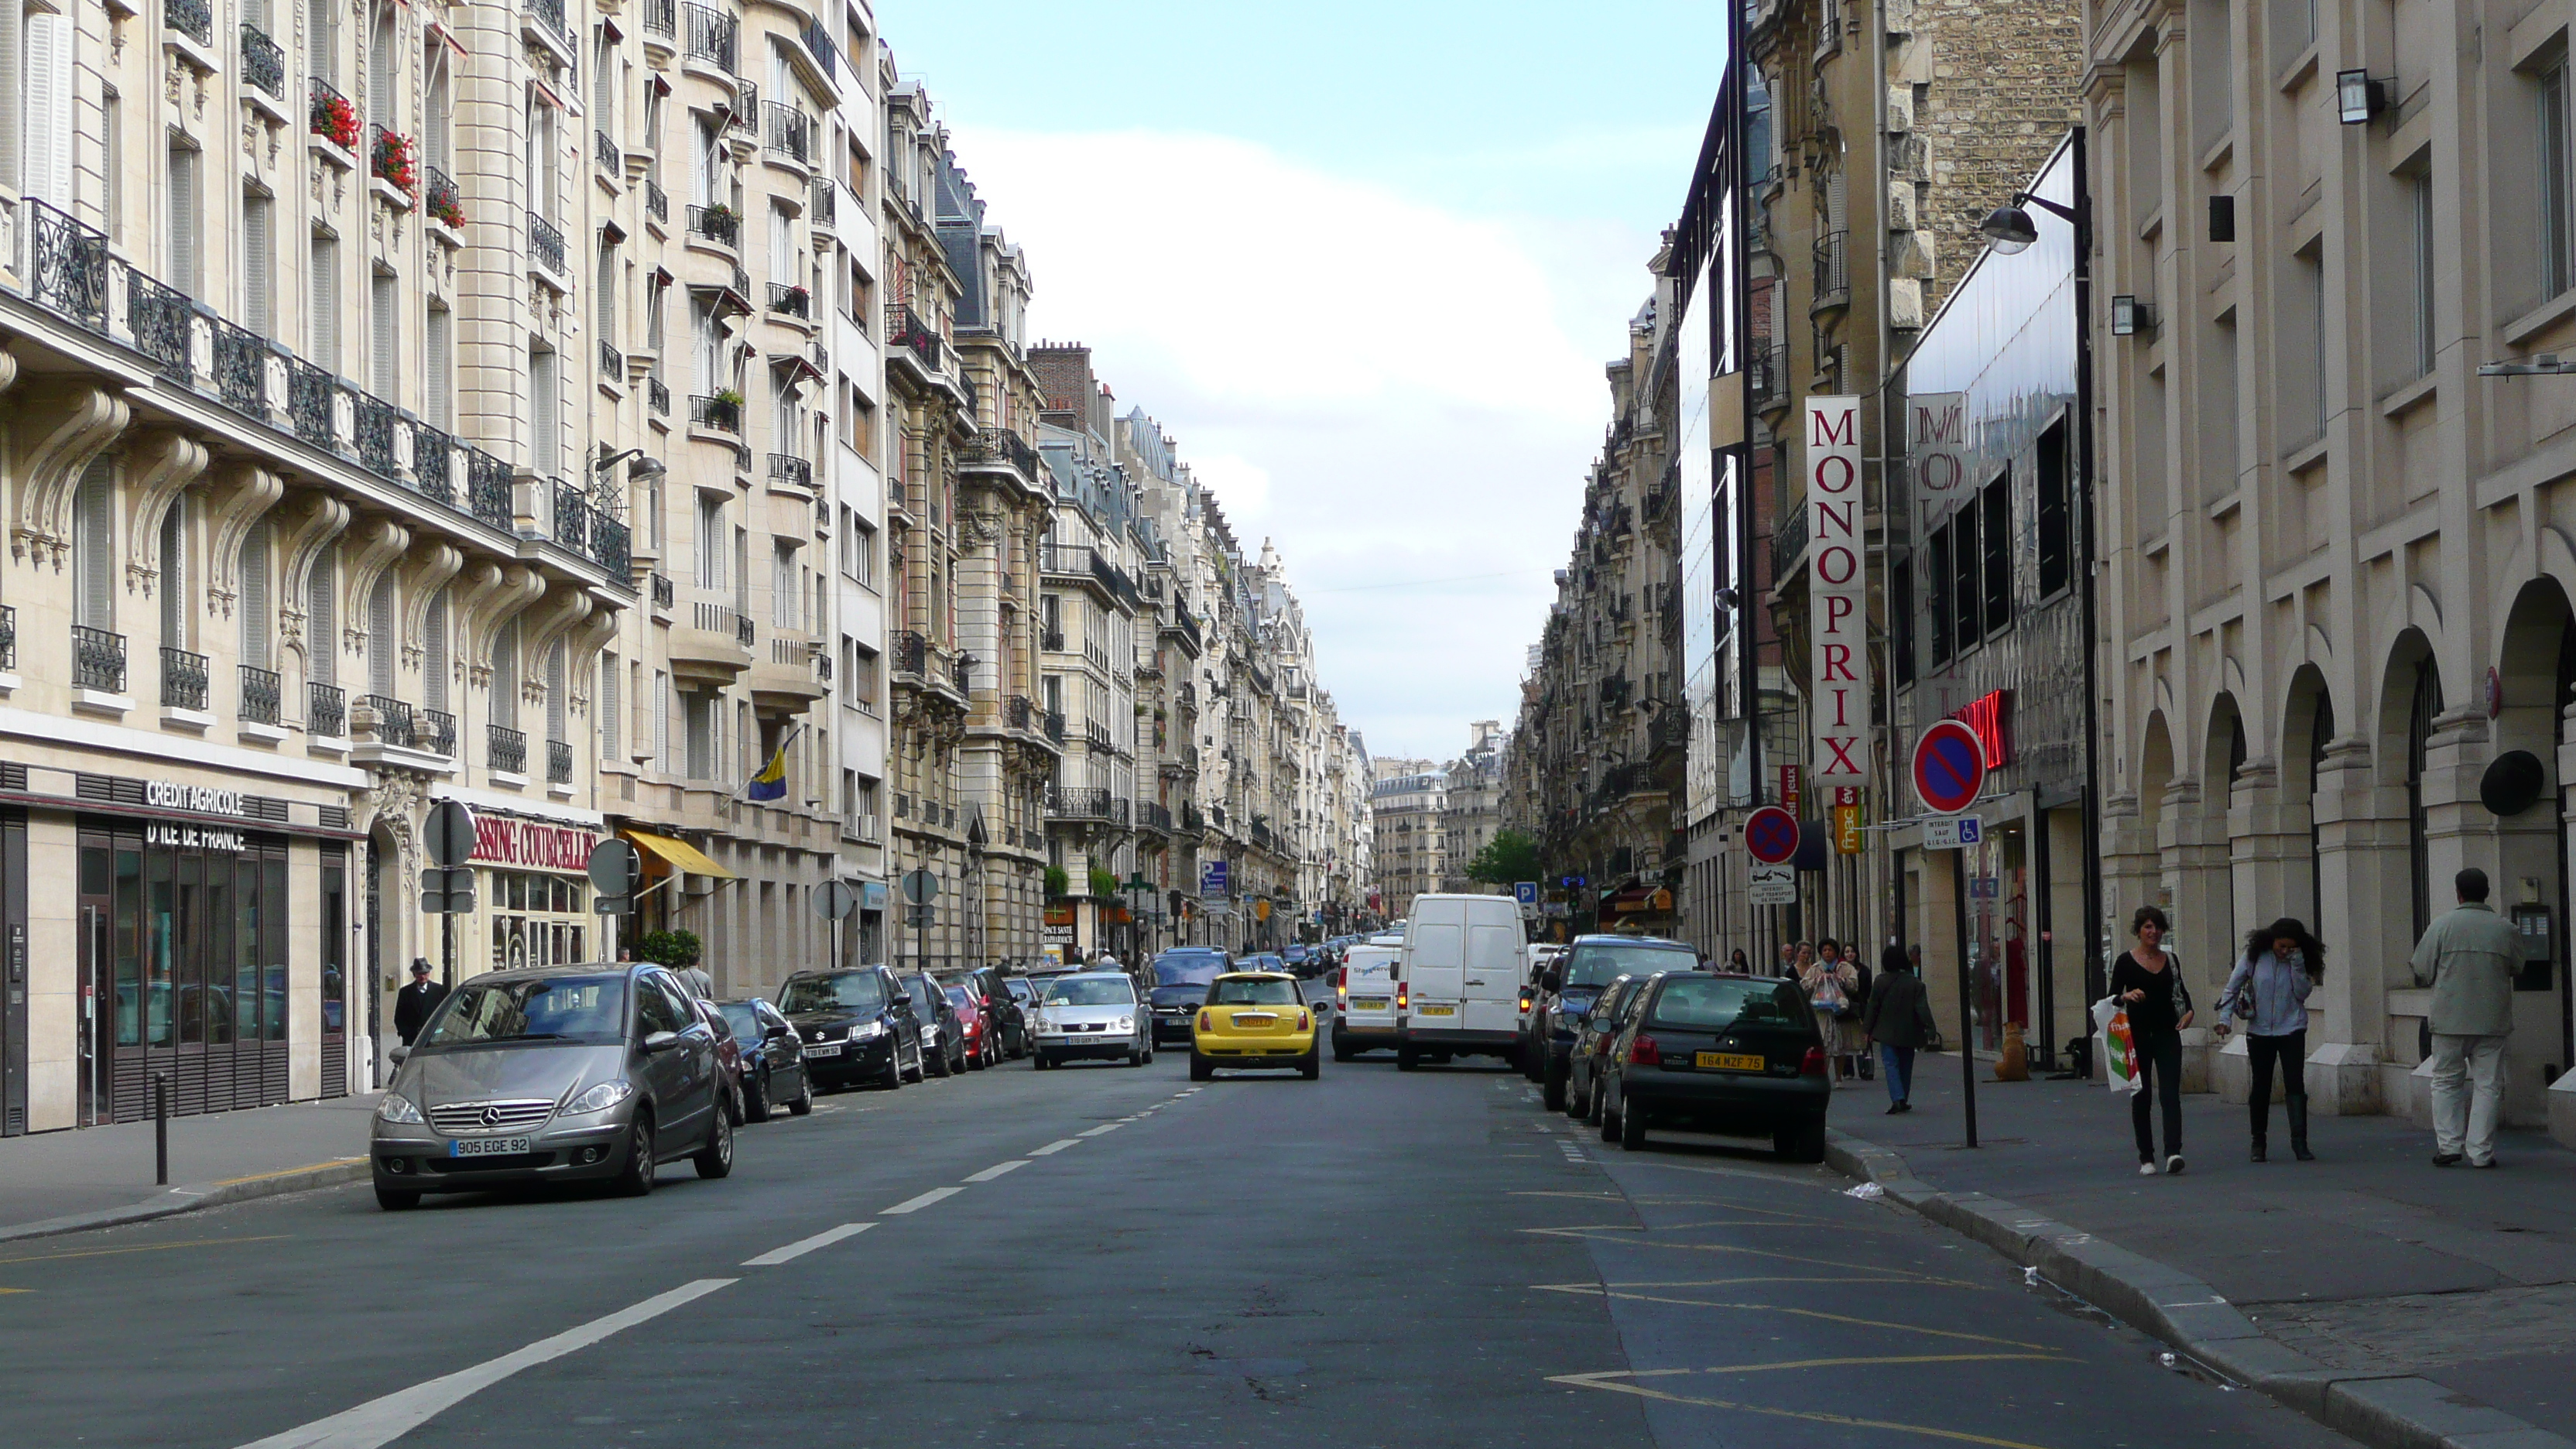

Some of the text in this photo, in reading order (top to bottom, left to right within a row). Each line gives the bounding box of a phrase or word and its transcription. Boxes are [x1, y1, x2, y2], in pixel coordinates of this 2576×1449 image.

[1810, 409, 1862, 775] MONOPRIX
[1786, 767, 1799, 793] jeux
[147, 778, 245, 816] CRÉDIT AGRICOLE
[183, 825, 199, 847] DE
[202, 827, 245, 851] FRANCE
[1841, 809, 1855, 850] fnac
[1521, 886, 1530, 900] P
[1702, 1056, 1760, 1068] 164 MZF 75
[458, 1139, 527, 1154] 905 EGE 92
